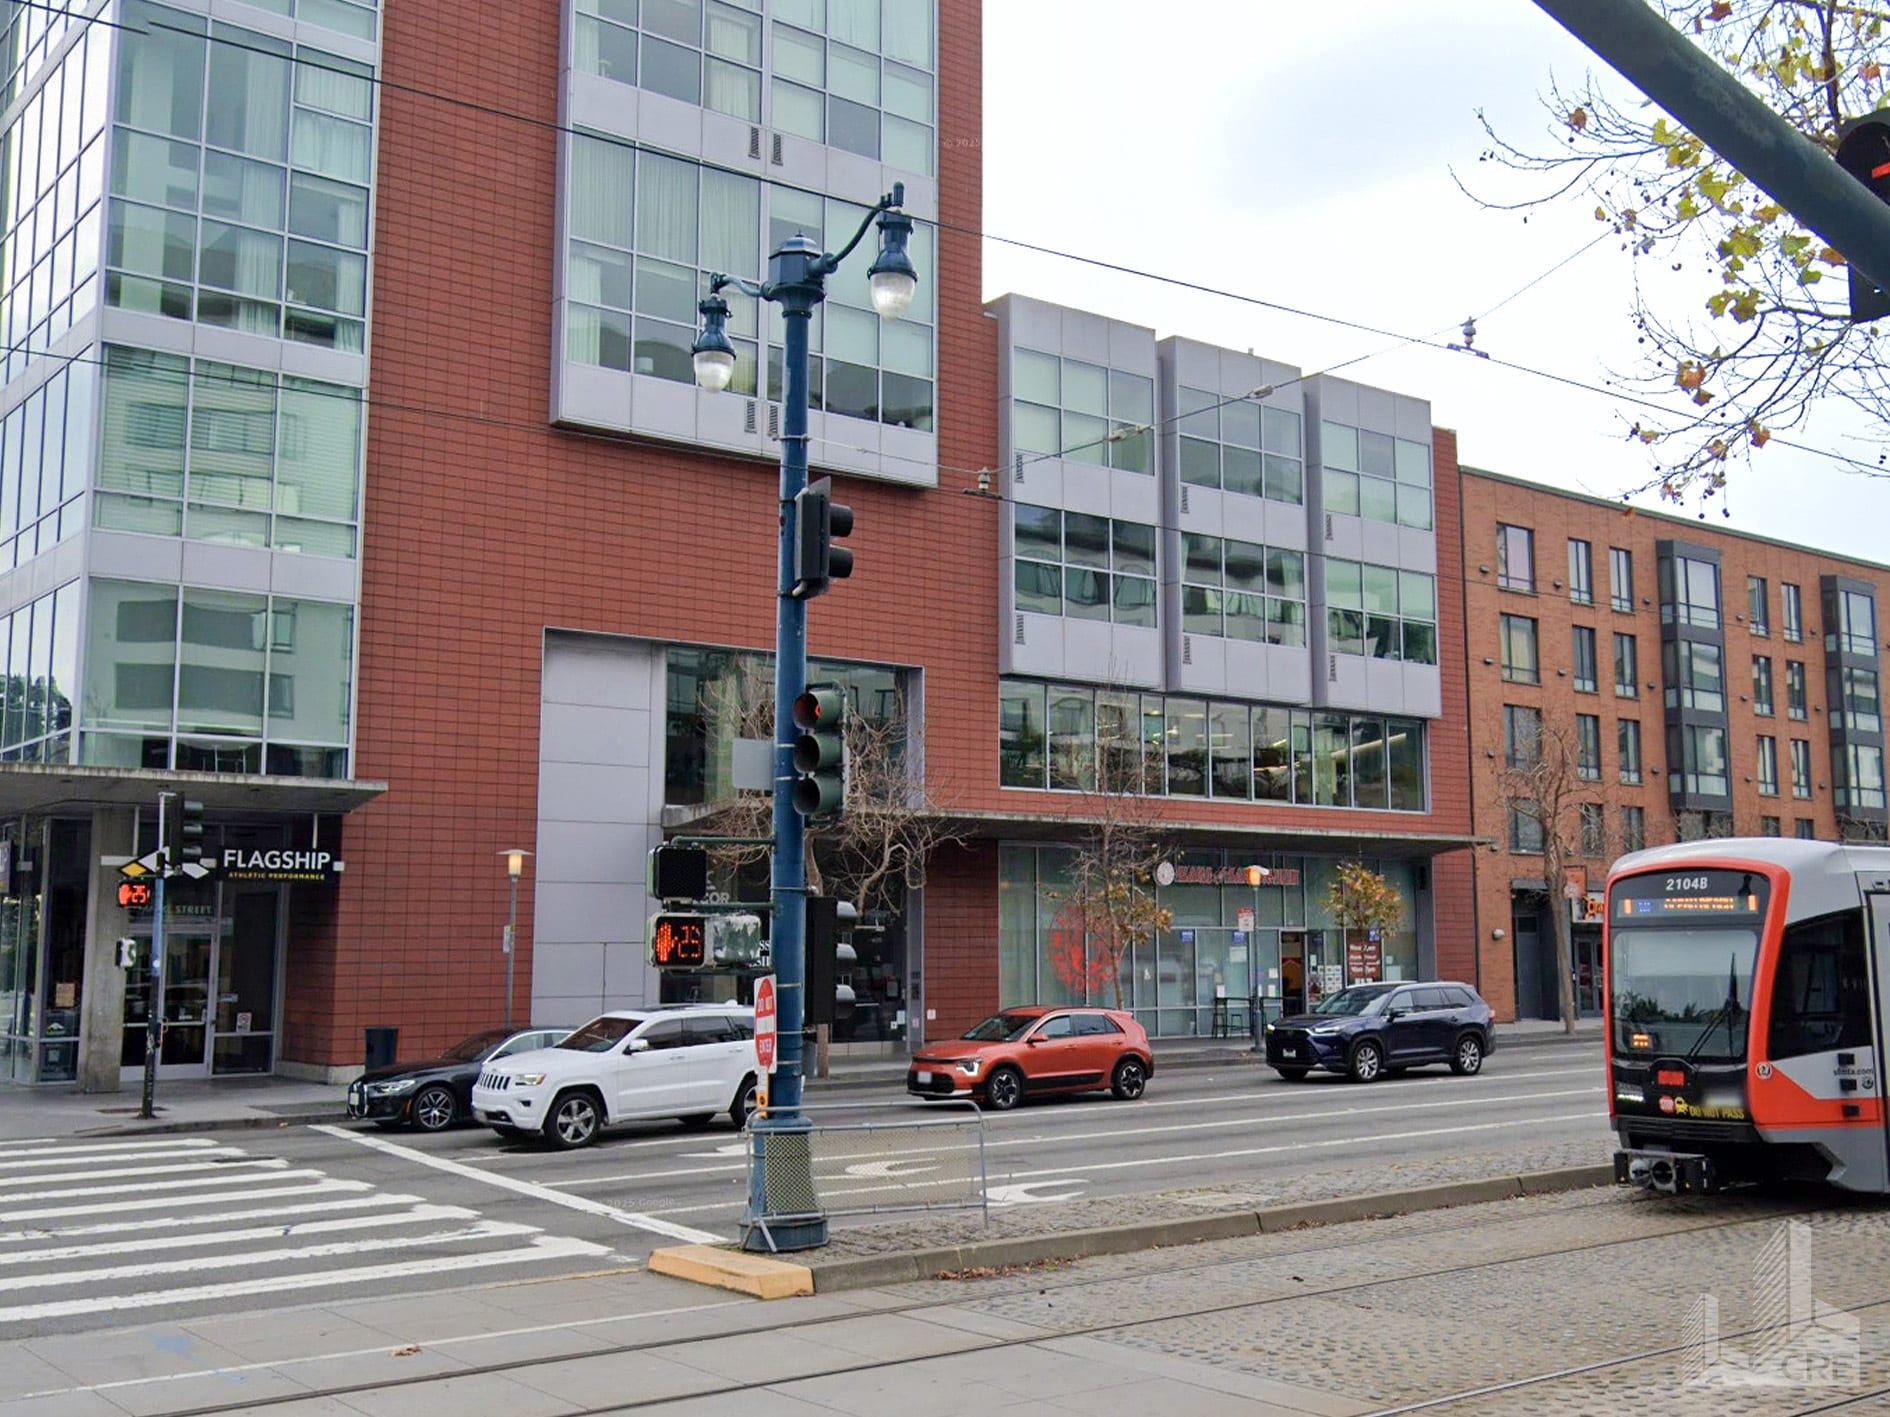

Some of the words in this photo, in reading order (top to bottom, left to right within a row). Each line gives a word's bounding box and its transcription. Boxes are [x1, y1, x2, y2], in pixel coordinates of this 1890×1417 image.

[223, 849, 331, 870] FLAGSHIP
[228, 872, 265, 880] ATHLETIC
[268, 872, 325, 881] PERFORMANCE
[1665, 877, 1709, 891] 2104B
[757, 997, 765, 1012] DO
[1689, 1106, 1702, 1118] DO
[1722, 1108, 1745, 1121] PASS
